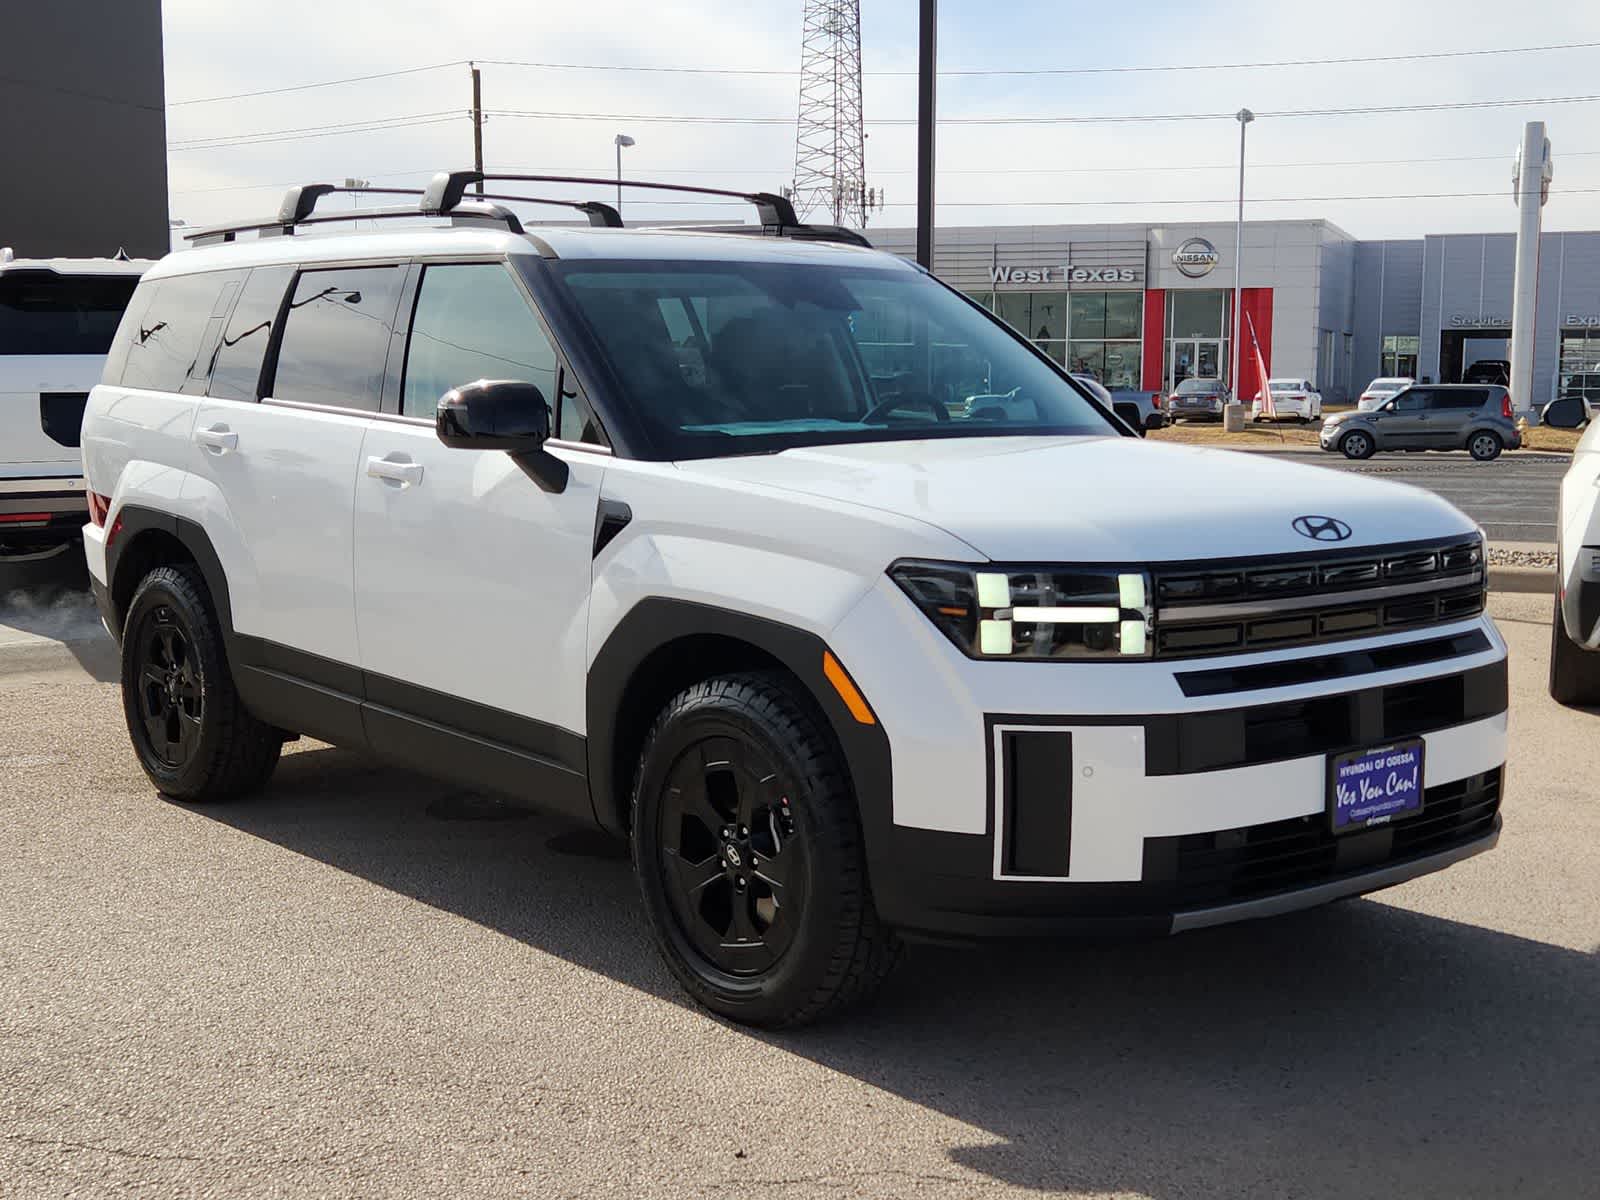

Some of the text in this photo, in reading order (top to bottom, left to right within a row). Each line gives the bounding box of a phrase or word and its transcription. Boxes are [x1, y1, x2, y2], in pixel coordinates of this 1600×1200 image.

[1176, 254, 1215, 262] NISSAN
[989, 264, 1135, 283] West Texas
[1451, 313, 1513, 327] Service
[1340, 752, 1415, 777] HYUNDAI OF ODESSA
[1336, 783, 1356, 808] Yes
[1359, 777, 1384, 802] You
[1386, 765, 1418, 796] Can!
